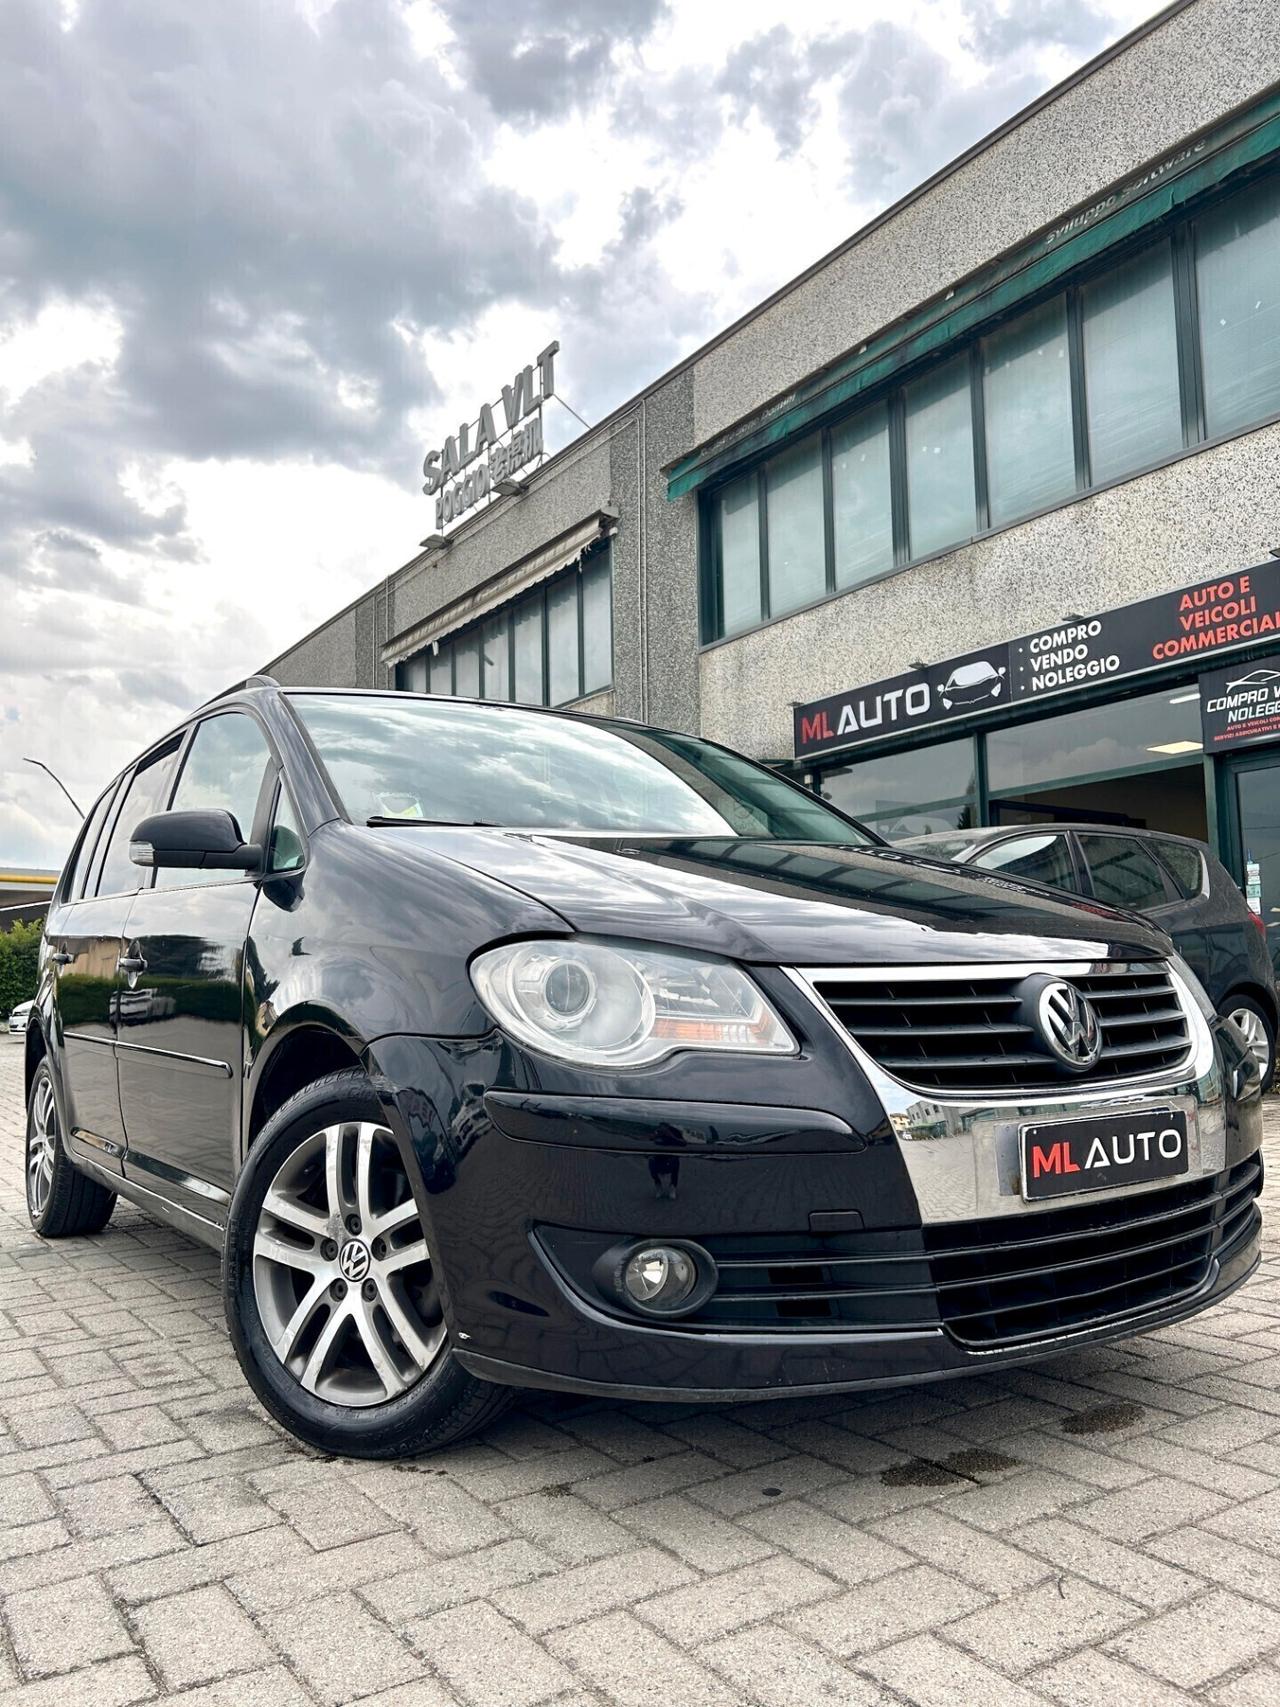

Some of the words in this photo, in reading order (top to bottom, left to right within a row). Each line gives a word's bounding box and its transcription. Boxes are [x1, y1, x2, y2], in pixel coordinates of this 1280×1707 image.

[422, 403, 498, 496] SALA
[501, 340, 560, 430] VLT
[1179, 581, 1235, 611] AUTO
[1239, 575, 1250, 594] E
[1179, 596, 1257, 631] VEICOLI
[1030, 620, 1102, 653] COMPRO
[1030, 644, 1088, 672] VENDO
[1032, 655, 1120, 691] NOLEGGIO
[1207, 688, 1269, 713] COMPRO
[1084, 1129, 1182, 1170] AUTO
